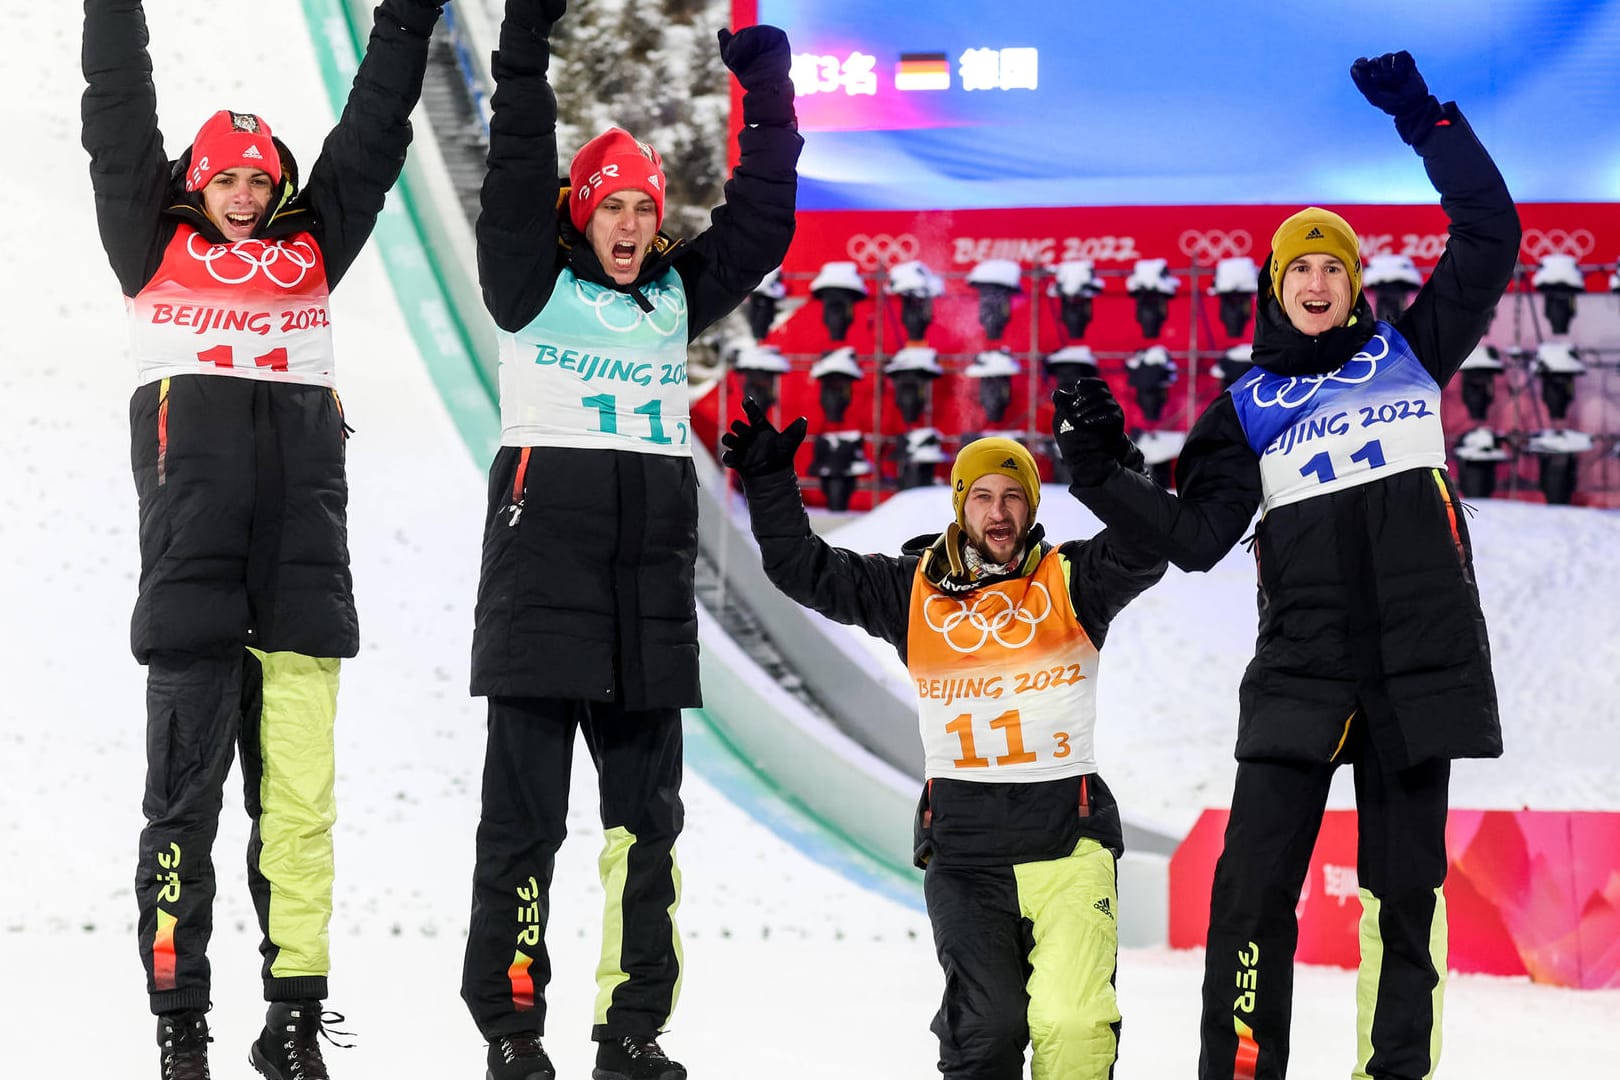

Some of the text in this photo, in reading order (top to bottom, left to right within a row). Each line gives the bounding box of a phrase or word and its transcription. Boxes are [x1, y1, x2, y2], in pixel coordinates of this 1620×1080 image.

[579, 164, 620, 200] GER
[1063, 236, 1141, 261] 2022
[152, 303, 330, 335] BEIJING 2022
[535, 344, 652, 386] BEIJING
[581, 393, 672, 444] 11
[1265, 400, 1434, 456] EIJING 2022
[1300, 439, 1387, 484] 11
[917, 663, 1087, 706] BEIJING 2022
[945, 709, 1072, 768] 11 3
[516, 876, 540, 946] GER
[1233, 941, 1260, 1013] GER
